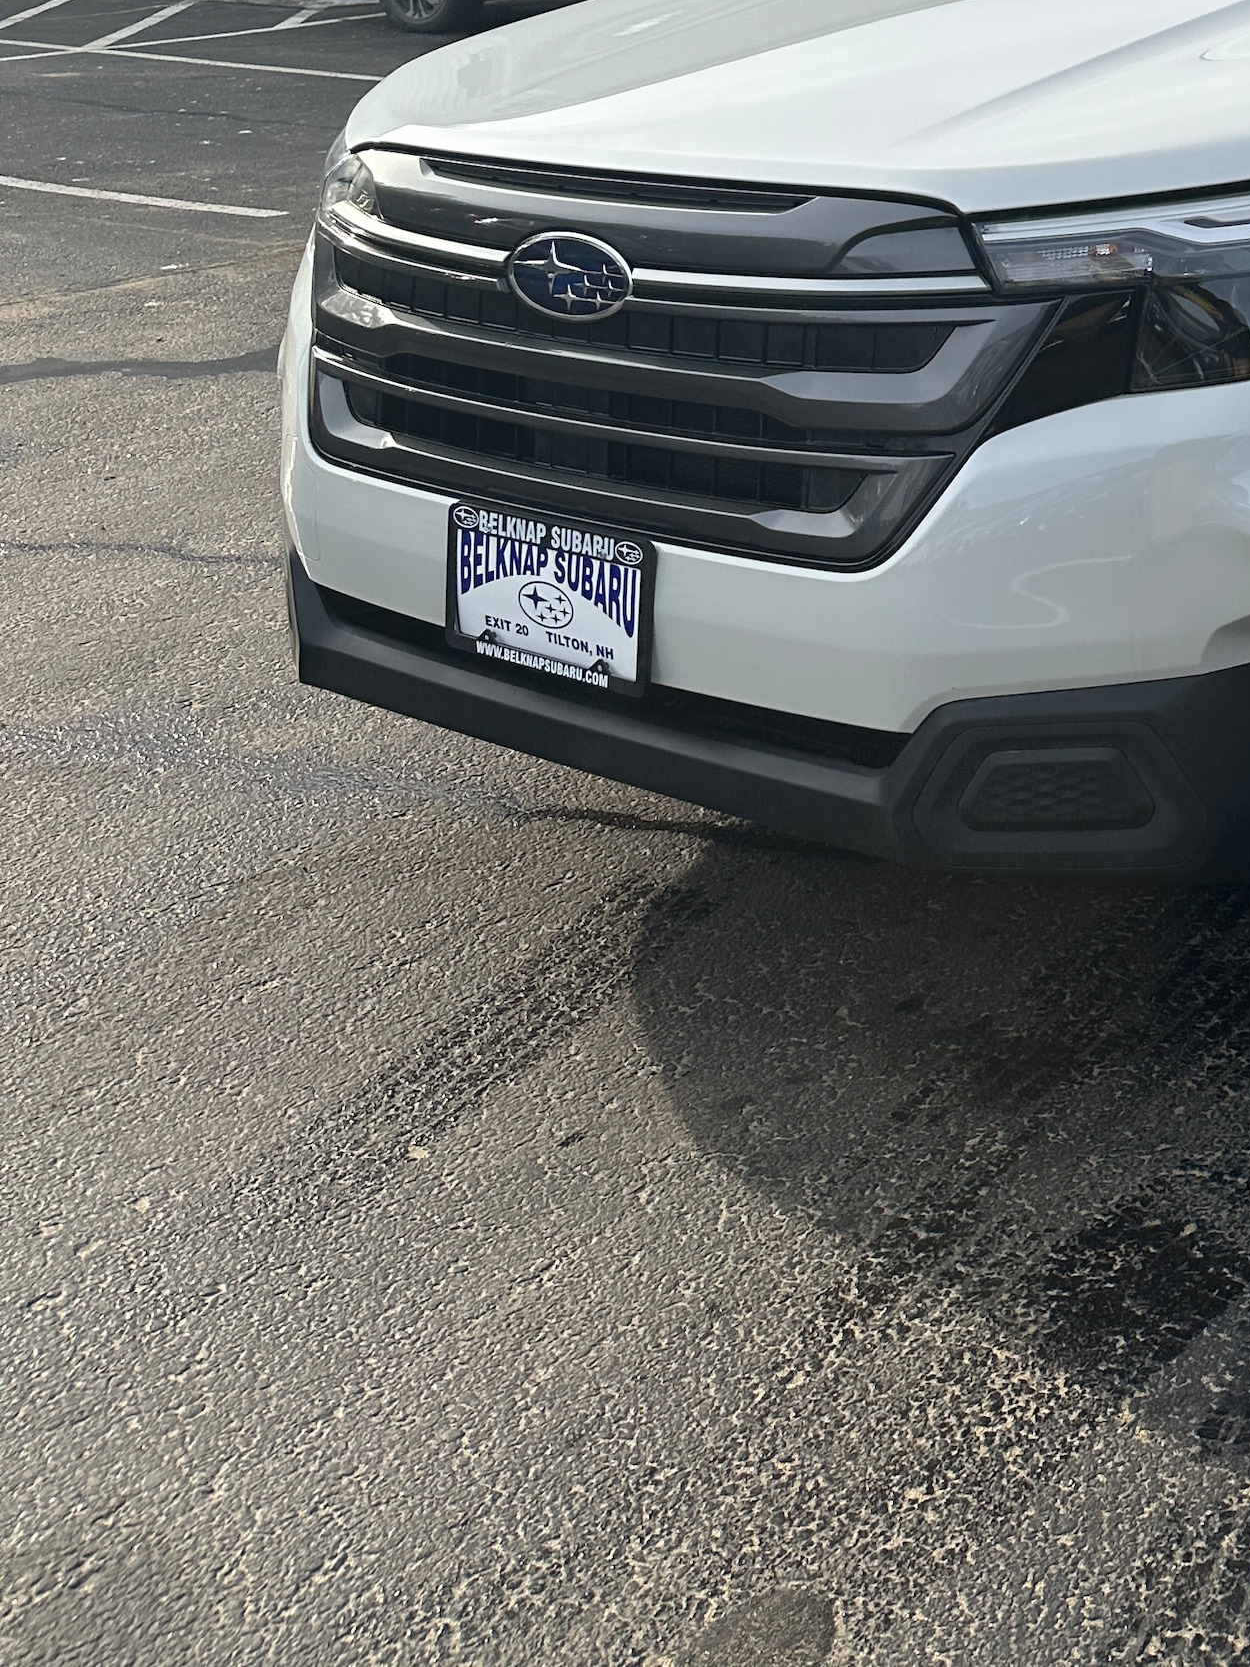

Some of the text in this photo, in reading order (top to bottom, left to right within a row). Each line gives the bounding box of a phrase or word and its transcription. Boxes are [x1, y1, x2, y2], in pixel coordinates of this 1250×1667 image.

[479, 509, 615, 561] BELKNAP SUBARU
[461, 529, 637, 638] BELKNAP SUBARU
[485, 615, 614, 660] EXIT 20 TILTON, NH
[476, 640, 608, 688] WWW.BELKNAPSUBARU.COM
